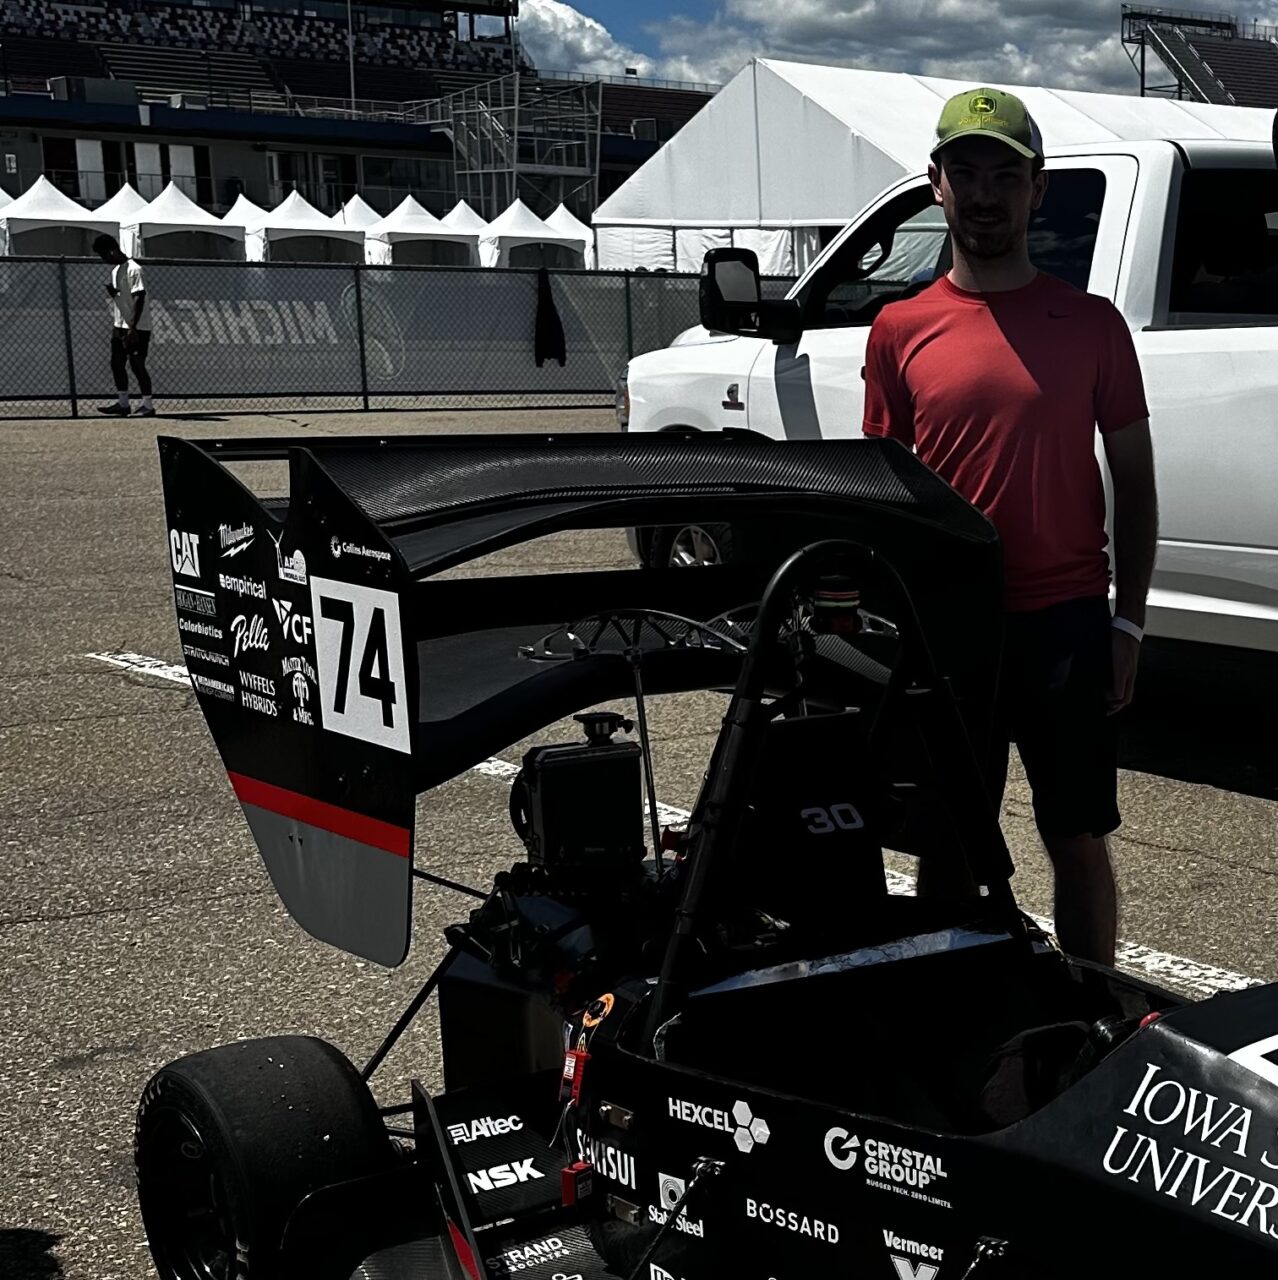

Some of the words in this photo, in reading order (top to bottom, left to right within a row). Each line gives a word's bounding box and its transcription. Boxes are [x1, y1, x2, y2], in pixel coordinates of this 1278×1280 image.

[170, 529, 200, 577] CAT
[342, 542, 361, 556] Collins
[362, 545, 391, 562] Aerospace
[225, 575, 267, 600] empirical
[179, 618, 223, 639] Colorbiotics
[230, 614, 270, 658] Pella
[320, 595, 397, 729] 74
[239, 670, 275, 696] WYFFELS
[241, 690, 278, 717] HYBRIDS
[800, 803, 865, 834] 30
[668, 1097, 735, 1133] HEXCEL
[1122, 1062, 1253, 1157] IOWA
[470, 1115, 524, 1141] Altec
[576, 1128, 637, 1190] SKISUI
[864, 1138, 947, 1179] CRYSTAL
[467, 1157, 546, 1194] NSK
[866, 1178, 892, 1191] RUGGED
[910, 1190, 927, 1201] ZERO
[675, 1214, 705, 1238] Steel
[746, 1198, 839, 1244] BOSSARD
[883, 1229, 944, 1261] Vermeer
